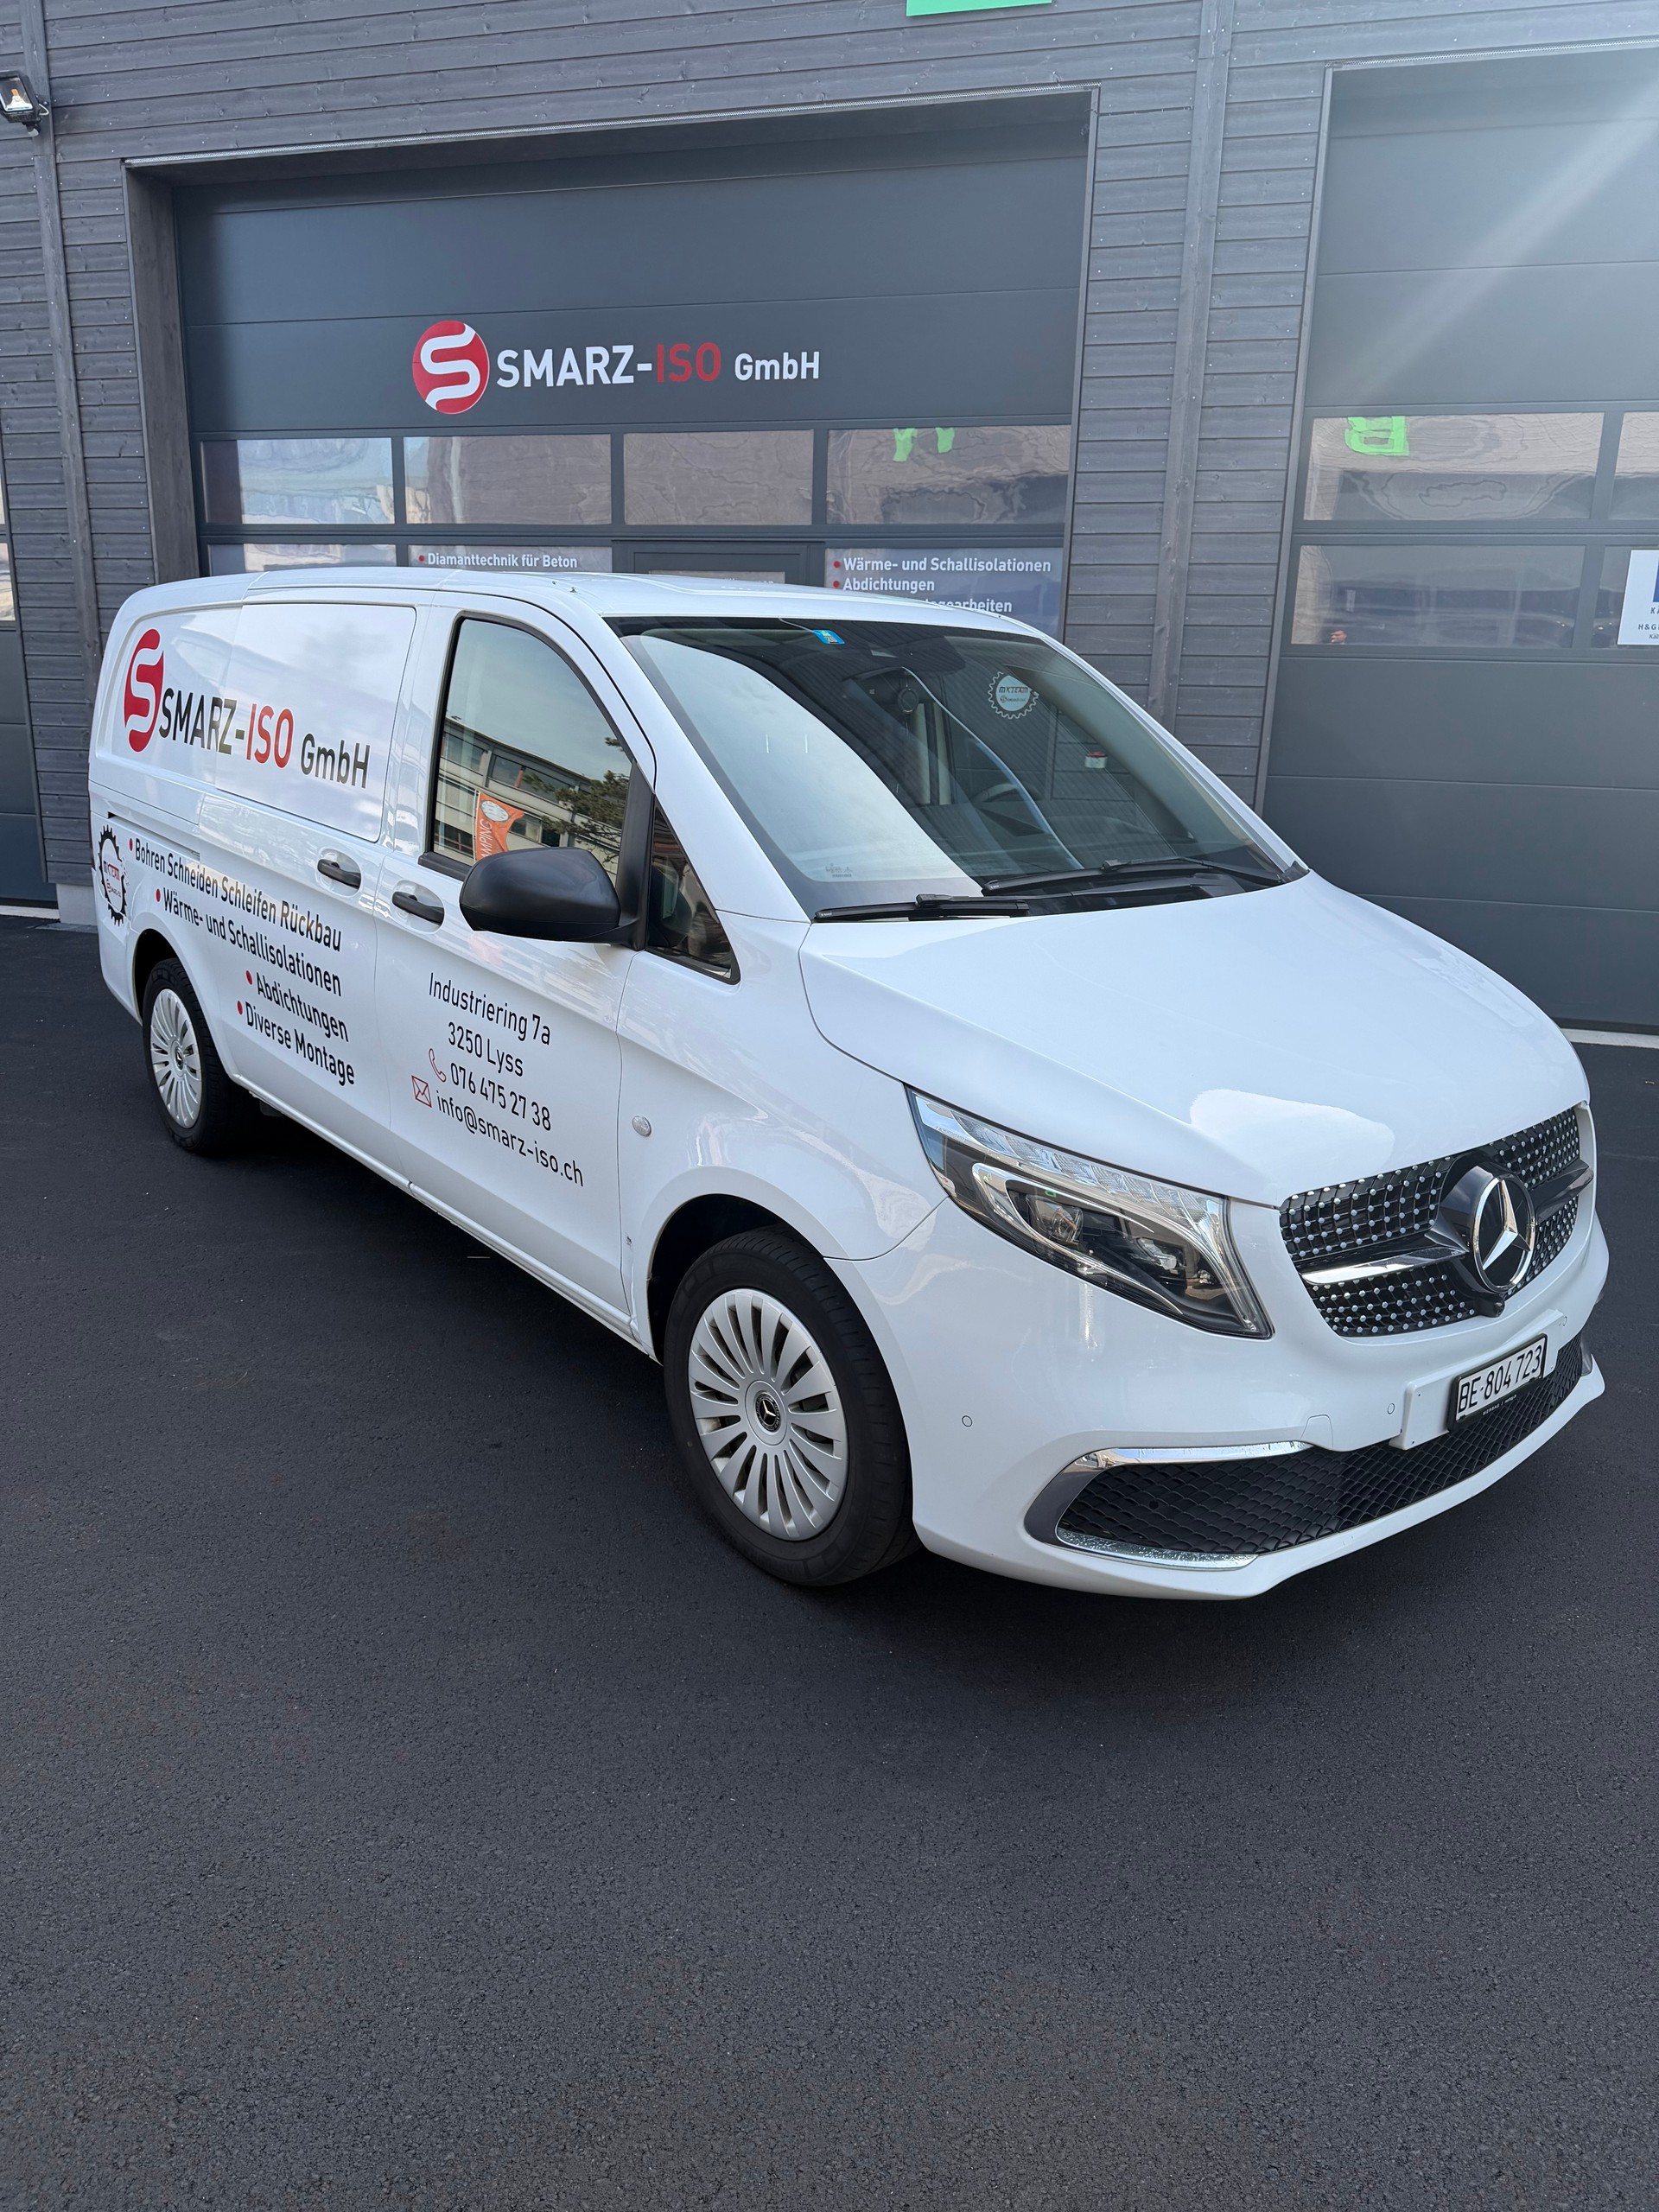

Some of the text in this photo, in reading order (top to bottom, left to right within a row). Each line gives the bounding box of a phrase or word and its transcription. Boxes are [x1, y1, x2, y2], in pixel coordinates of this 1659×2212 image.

[496, 342, 820, 388] SMARZ-ISO GmbH
[428, 553, 578, 569] Diamanttechnik für Beton
[842, 577, 935, 594] Abdichtungen
[843, 557, 1052, 572] Wärme- und Schallisolationen
[158, 688, 370, 788] SMARZ-ISO GmbH
[136, 838, 165, 873] Bohren
[168, 853, 218, 898] Schneiden
[221, 876, 276, 924] Schleifen
[280, 900, 341, 951] Rückbau
[163, 887, 203, 926] Wärme-
[206, 917, 226, 940] und
[228, 920, 341, 997] Schallisolationen
[256, 972, 348, 1042] Abdichtungen
[429, 972, 550, 1046] Industriering 7a
[245, 1001, 354, 1086] Diverse Montage
[448, 1022, 523, 1077] 3250 Lyss
[450, 1063, 551, 1131] 076 475 27 38
[436, 1090, 584, 1186] info@smarz-iso.ch
